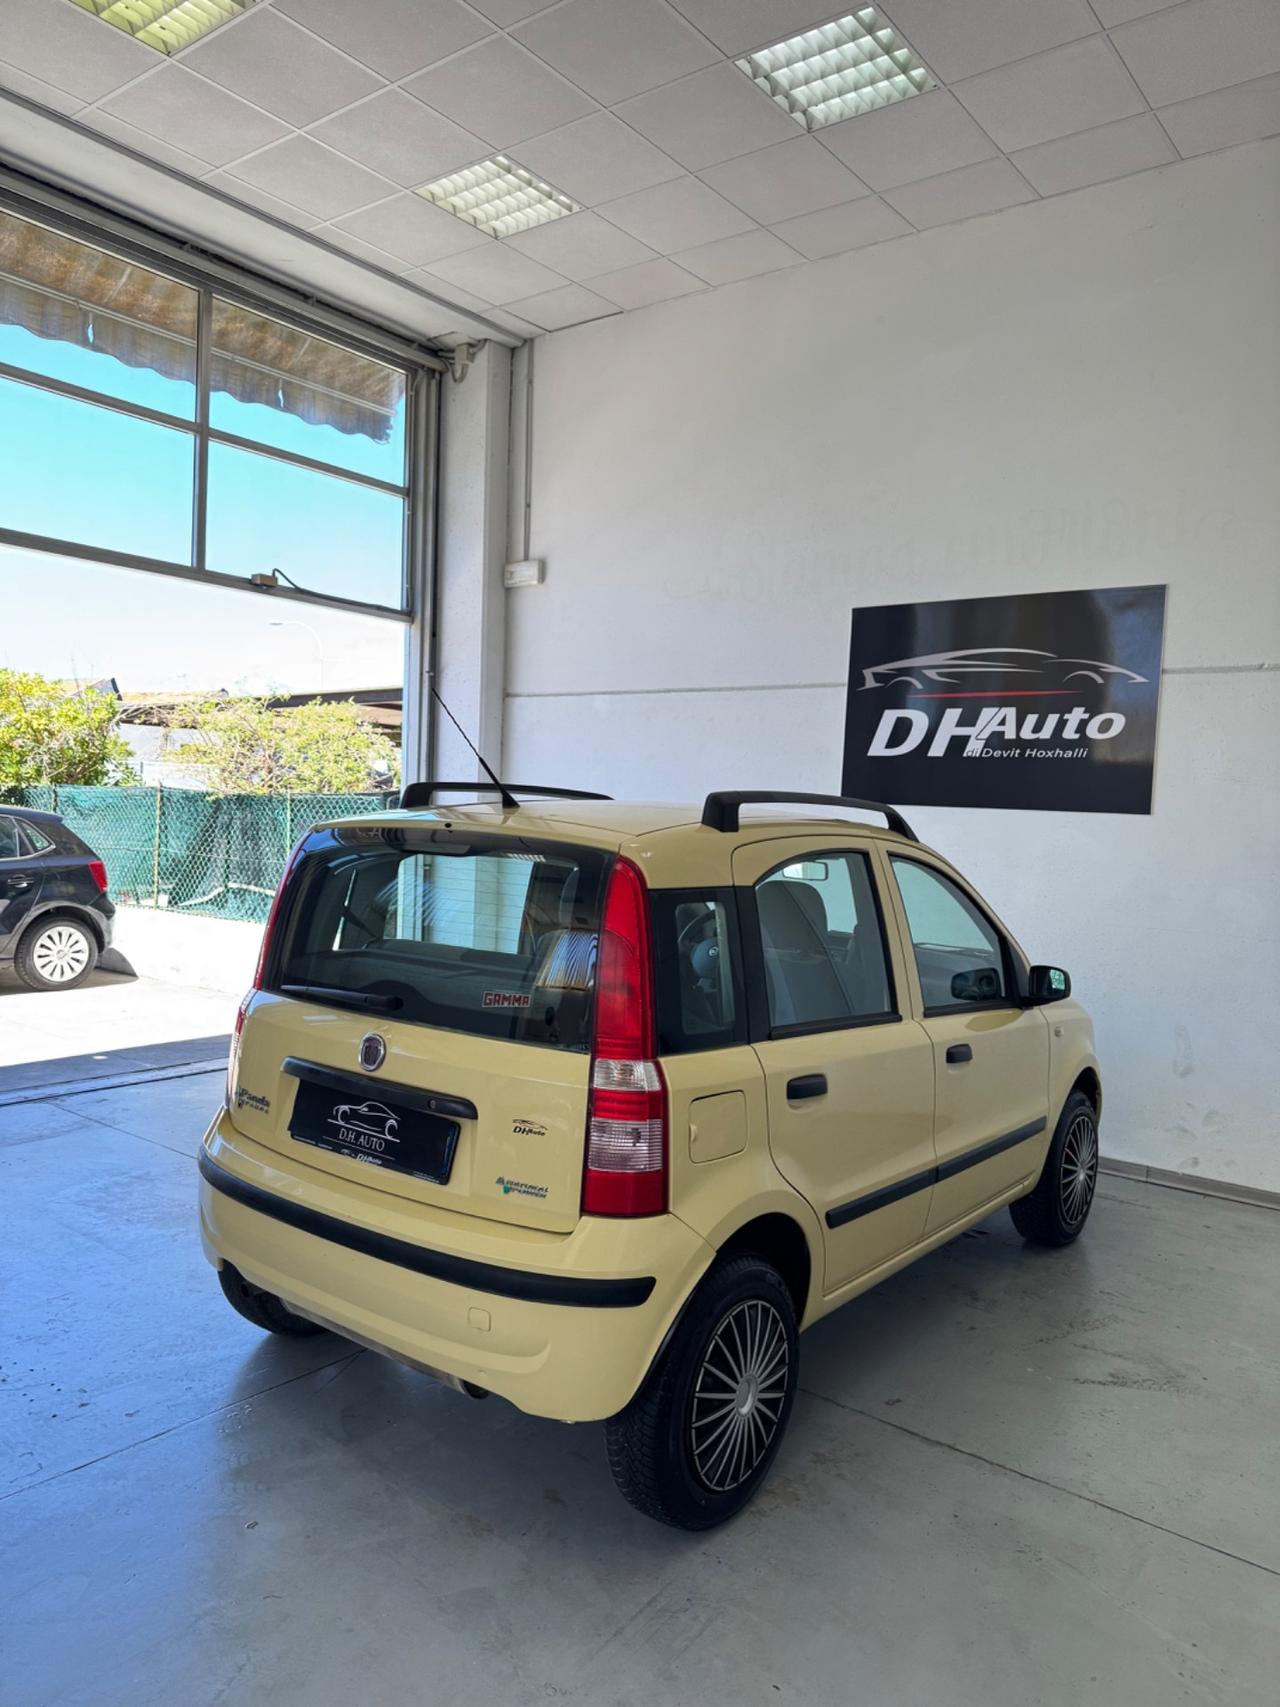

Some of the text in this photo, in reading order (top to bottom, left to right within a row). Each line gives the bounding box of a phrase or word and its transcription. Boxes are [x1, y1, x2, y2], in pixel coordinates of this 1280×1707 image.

[982, 747, 1021, 758] Devit
[1025, 747, 1088, 758] Hoxhalli
[484, 991, 530, 1006] GAMMA
[339, 1128, 356, 1143] D.H.
[358, 1133, 385, 1151] AUTO
